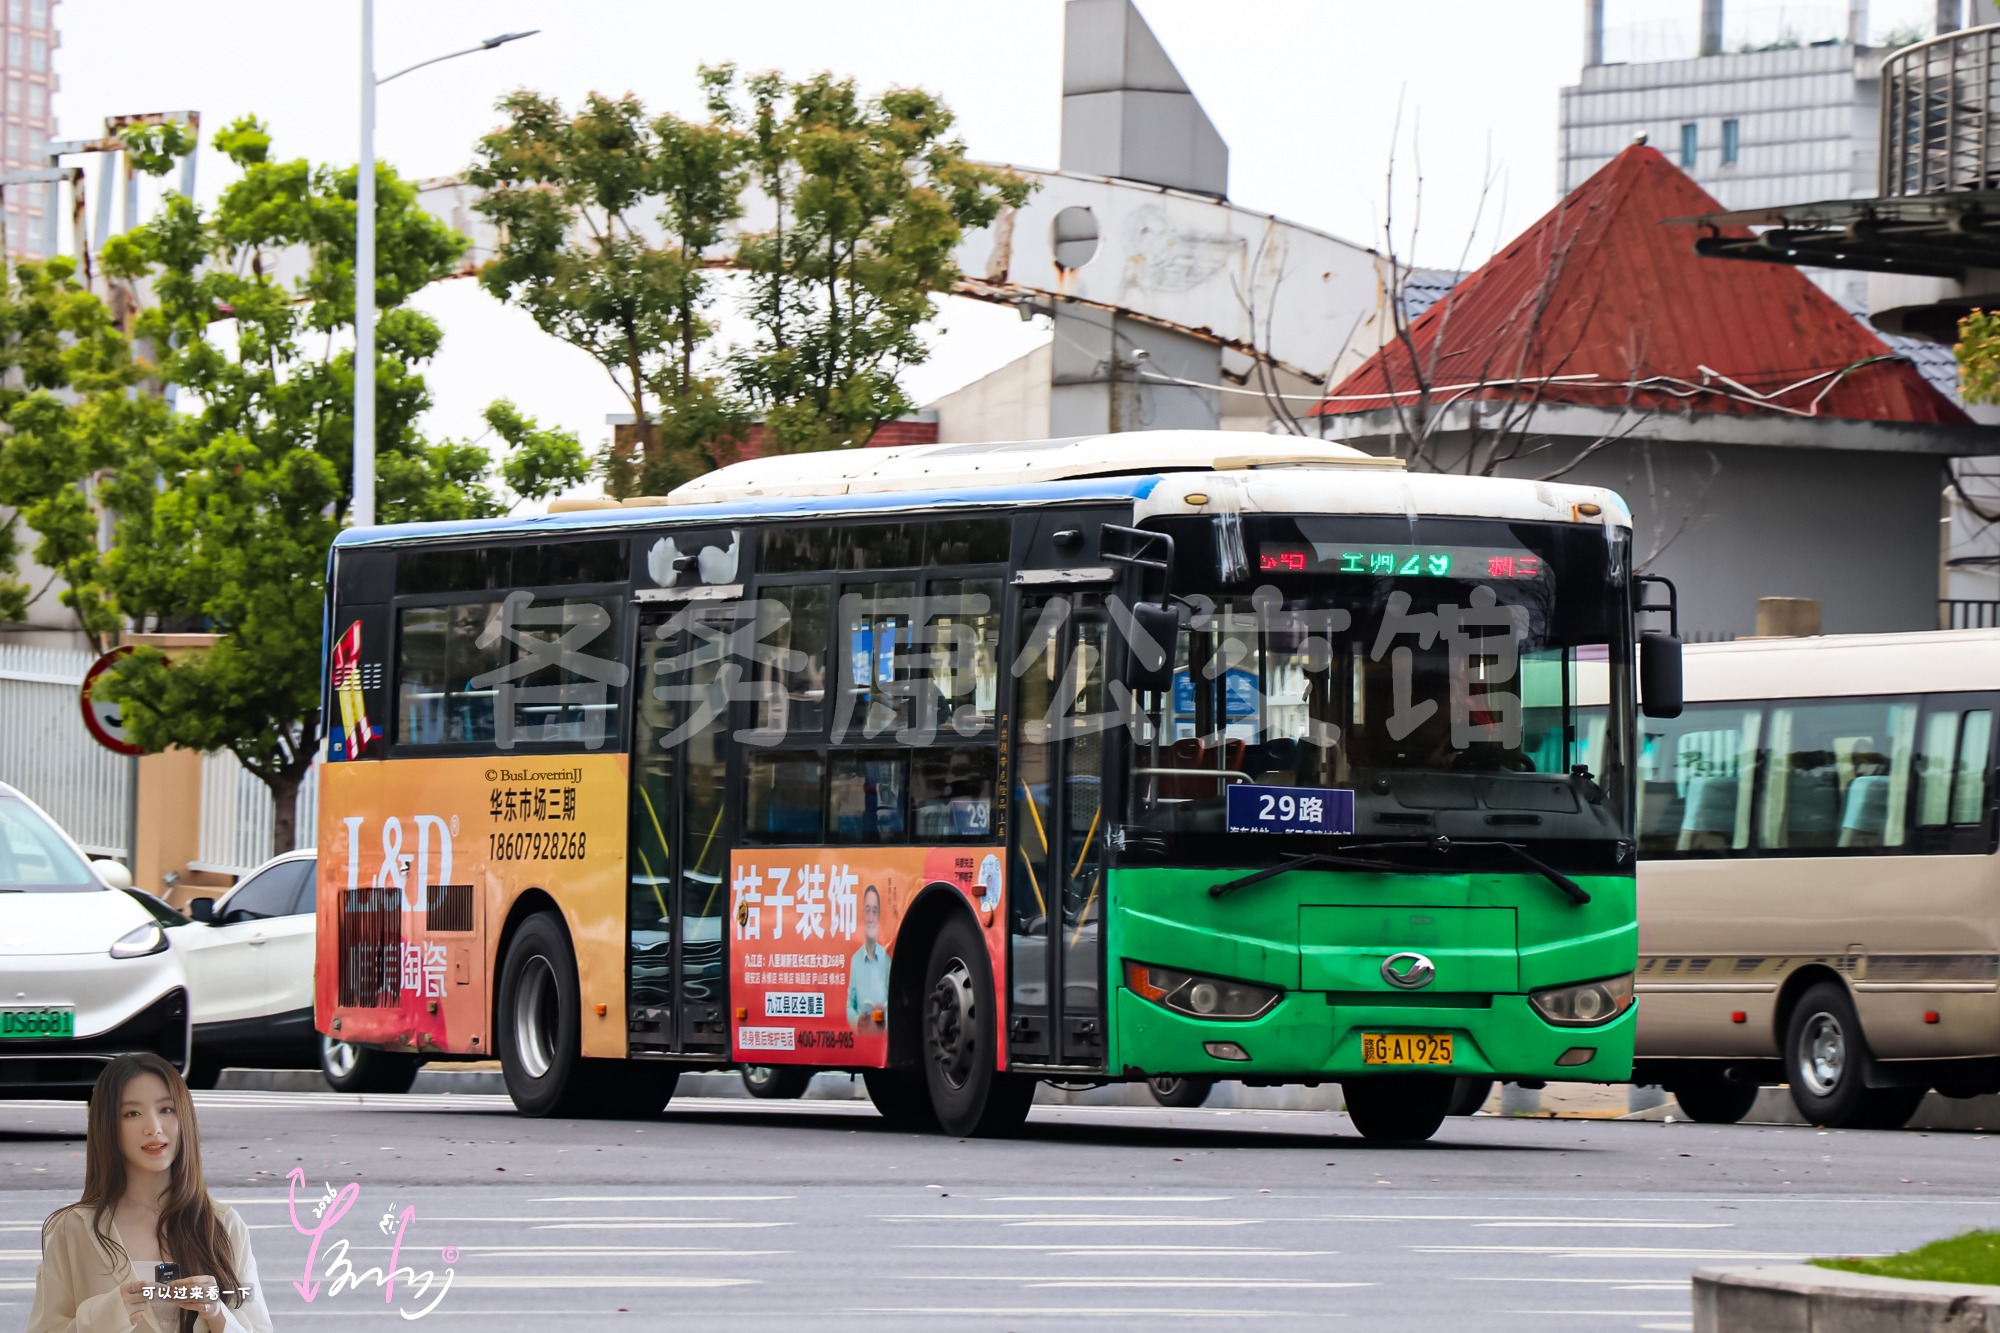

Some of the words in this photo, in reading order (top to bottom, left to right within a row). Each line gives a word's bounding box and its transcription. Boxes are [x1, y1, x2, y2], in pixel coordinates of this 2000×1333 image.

[490, 787, 576, 822] 华东市场三期
[1259, 794, 1323, 823] 29路
[490, 832, 586, 860] 18607928268
[733, 864, 859, 941] 桔子装饰
[766, 996, 824, 1015] 九江县区全覆盖
